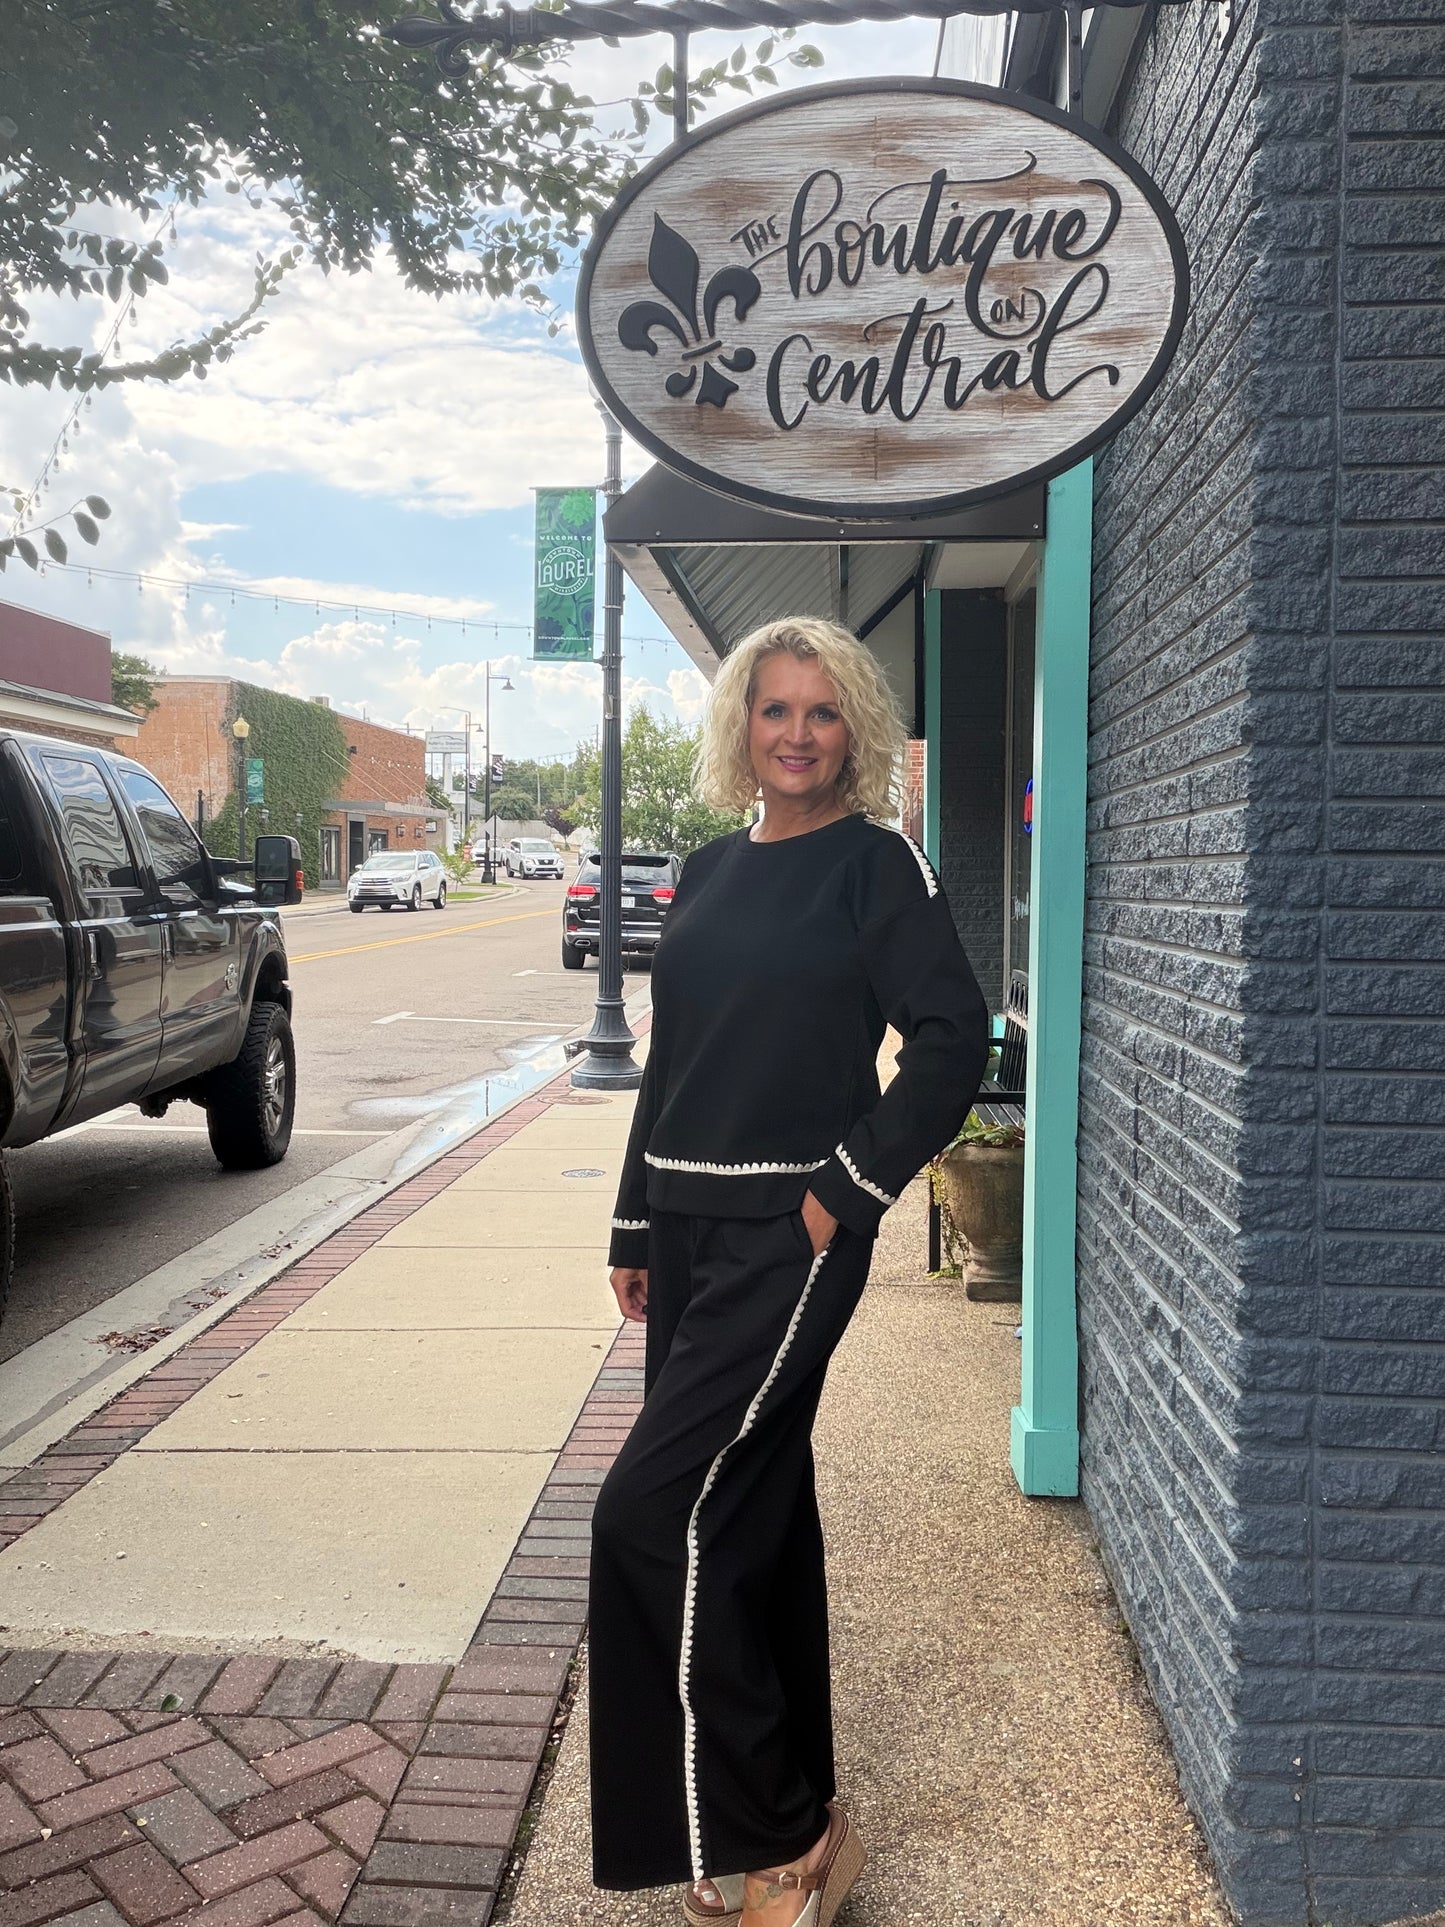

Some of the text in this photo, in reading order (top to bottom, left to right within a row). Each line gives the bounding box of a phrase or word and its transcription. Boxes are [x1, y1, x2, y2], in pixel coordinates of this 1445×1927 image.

[731, 150, 1121, 339] THE boutique
[989, 287, 1027, 324] ON
[766, 262, 1120, 431] Central
[537, 558, 594, 588] LAUREL
[545, 548, 581, 562] DOWNTOWN
